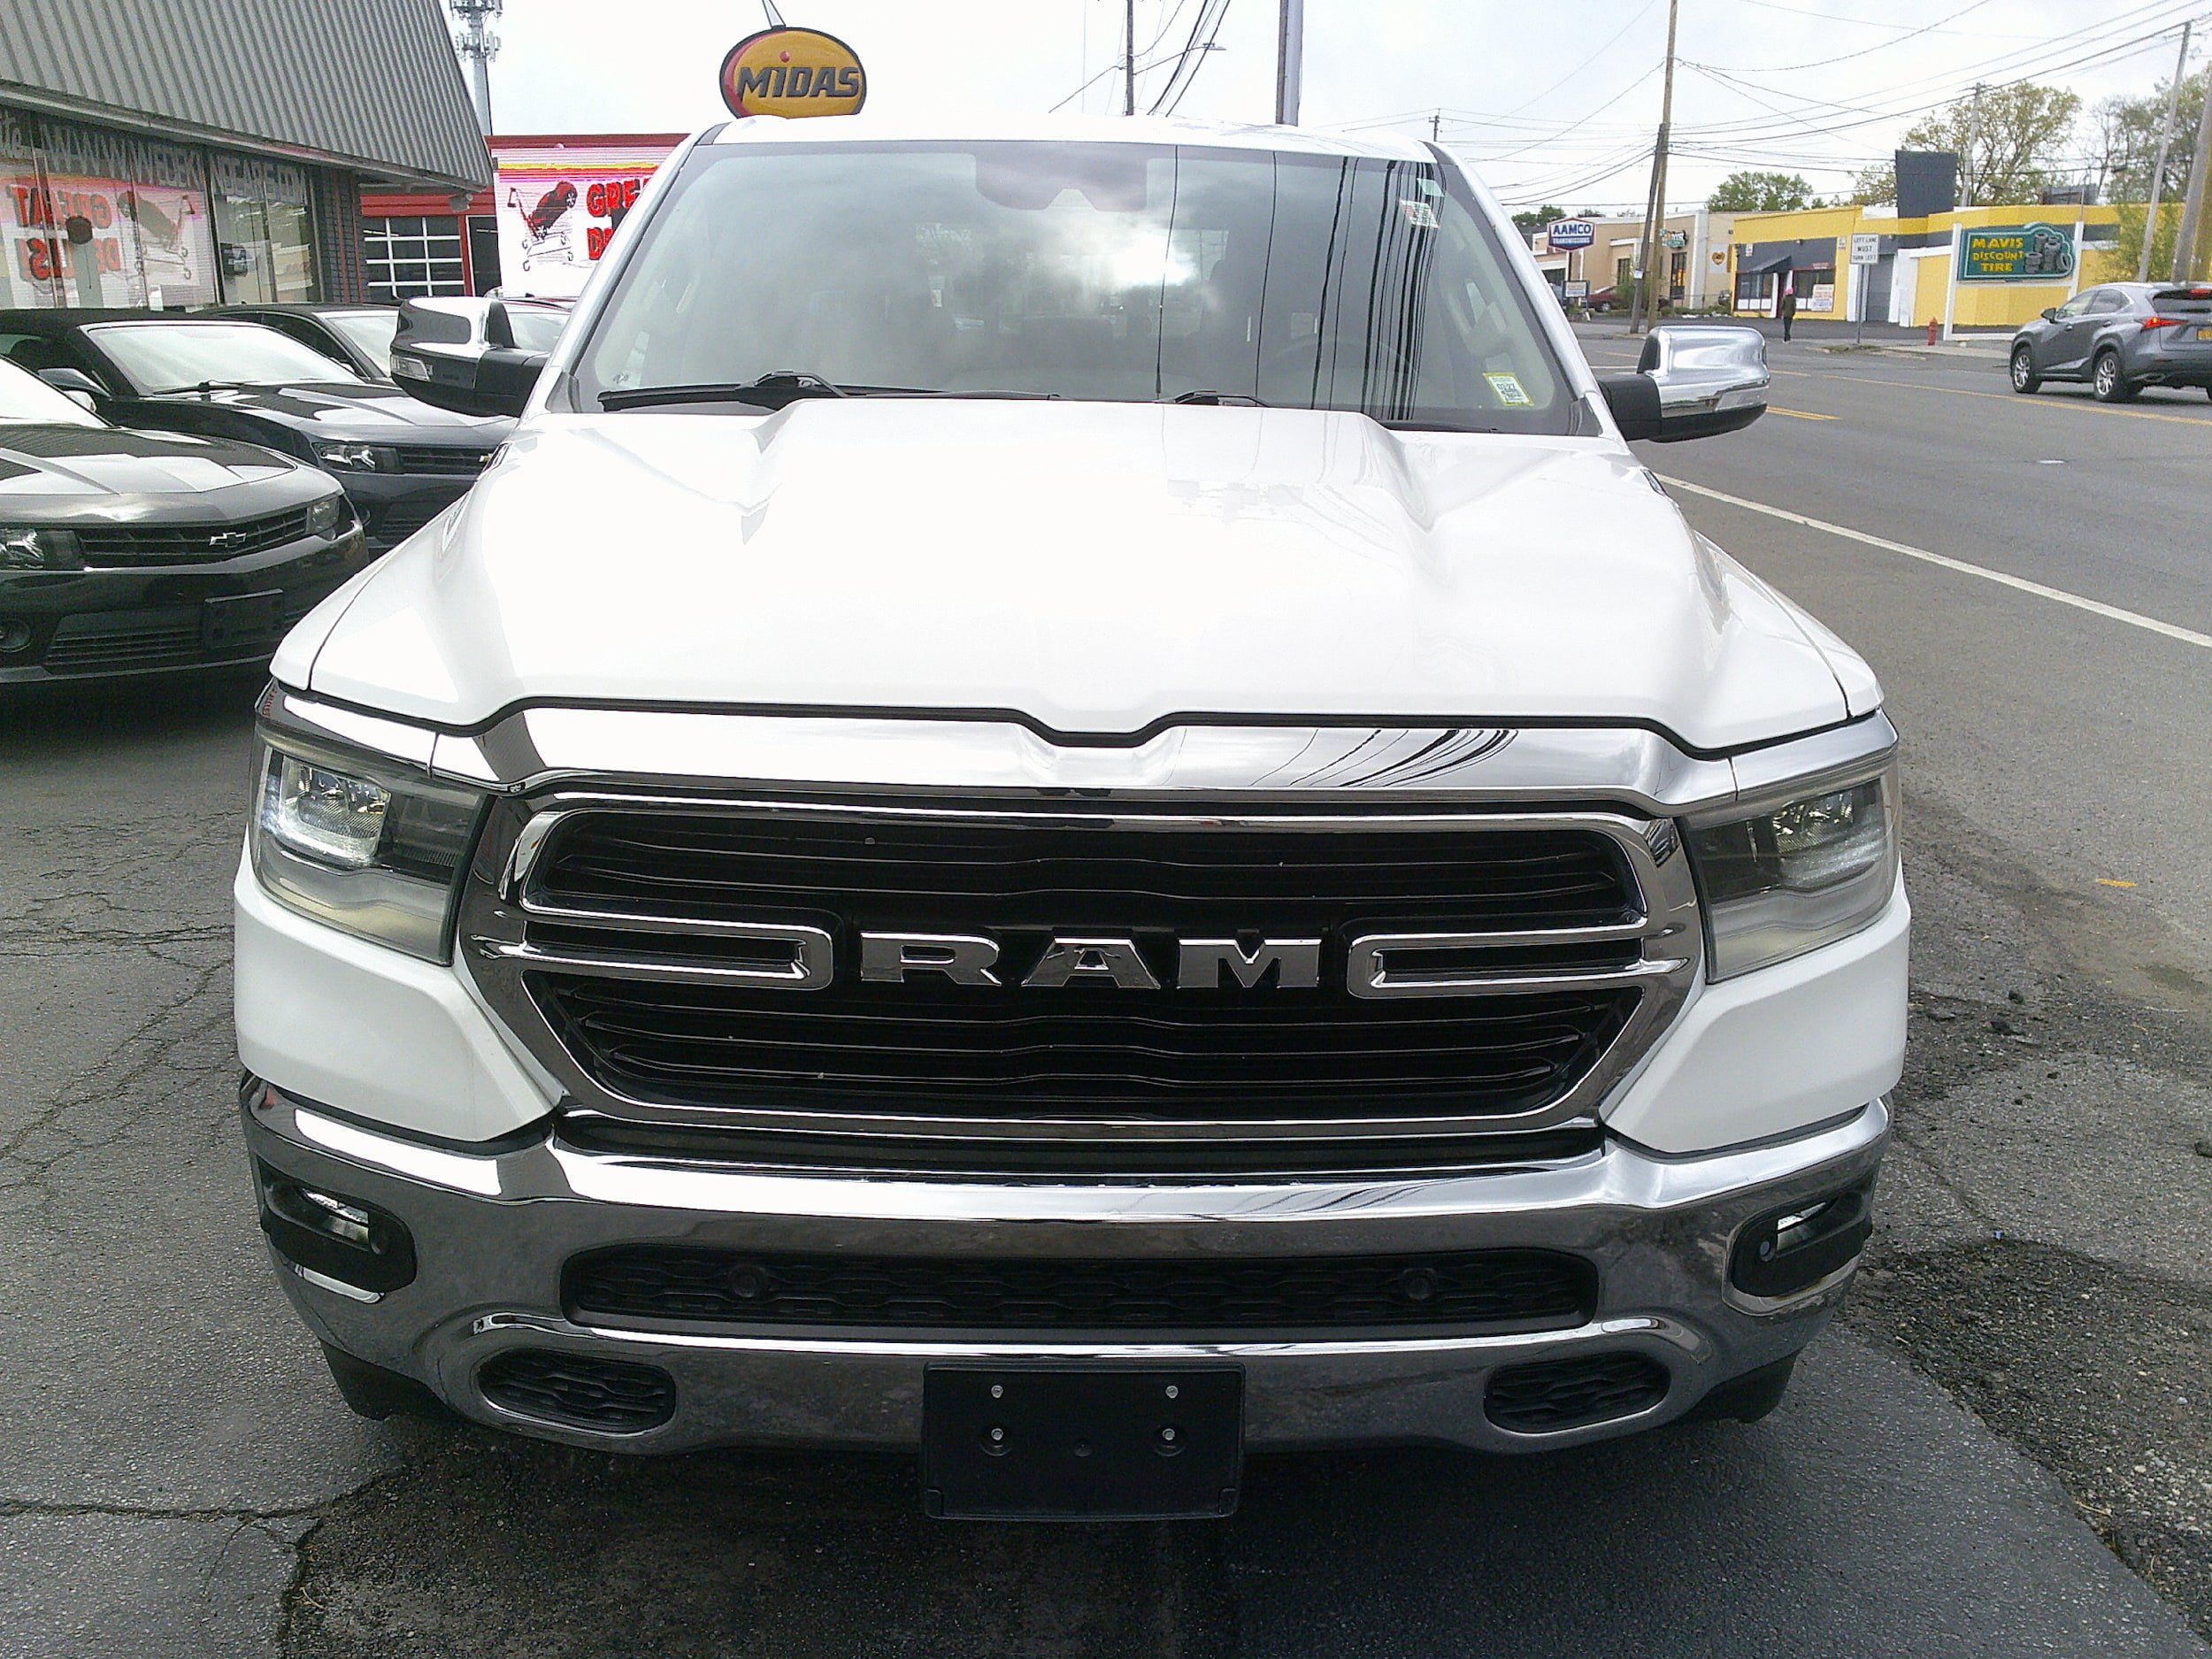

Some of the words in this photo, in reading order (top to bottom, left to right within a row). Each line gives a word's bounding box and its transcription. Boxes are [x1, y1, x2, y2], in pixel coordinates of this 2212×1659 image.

[736, 65, 859, 102] MIDAS
[587, 178, 649, 218] GRE
[1553, 224, 1592, 235] AAMCO
[1971, 237, 2024, 249] MAVIS
[1972, 250, 2024, 261] DISCOUNT
[1980, 263, 2013, 273] TIRE
[860, 931, 1322, 989] RAM
